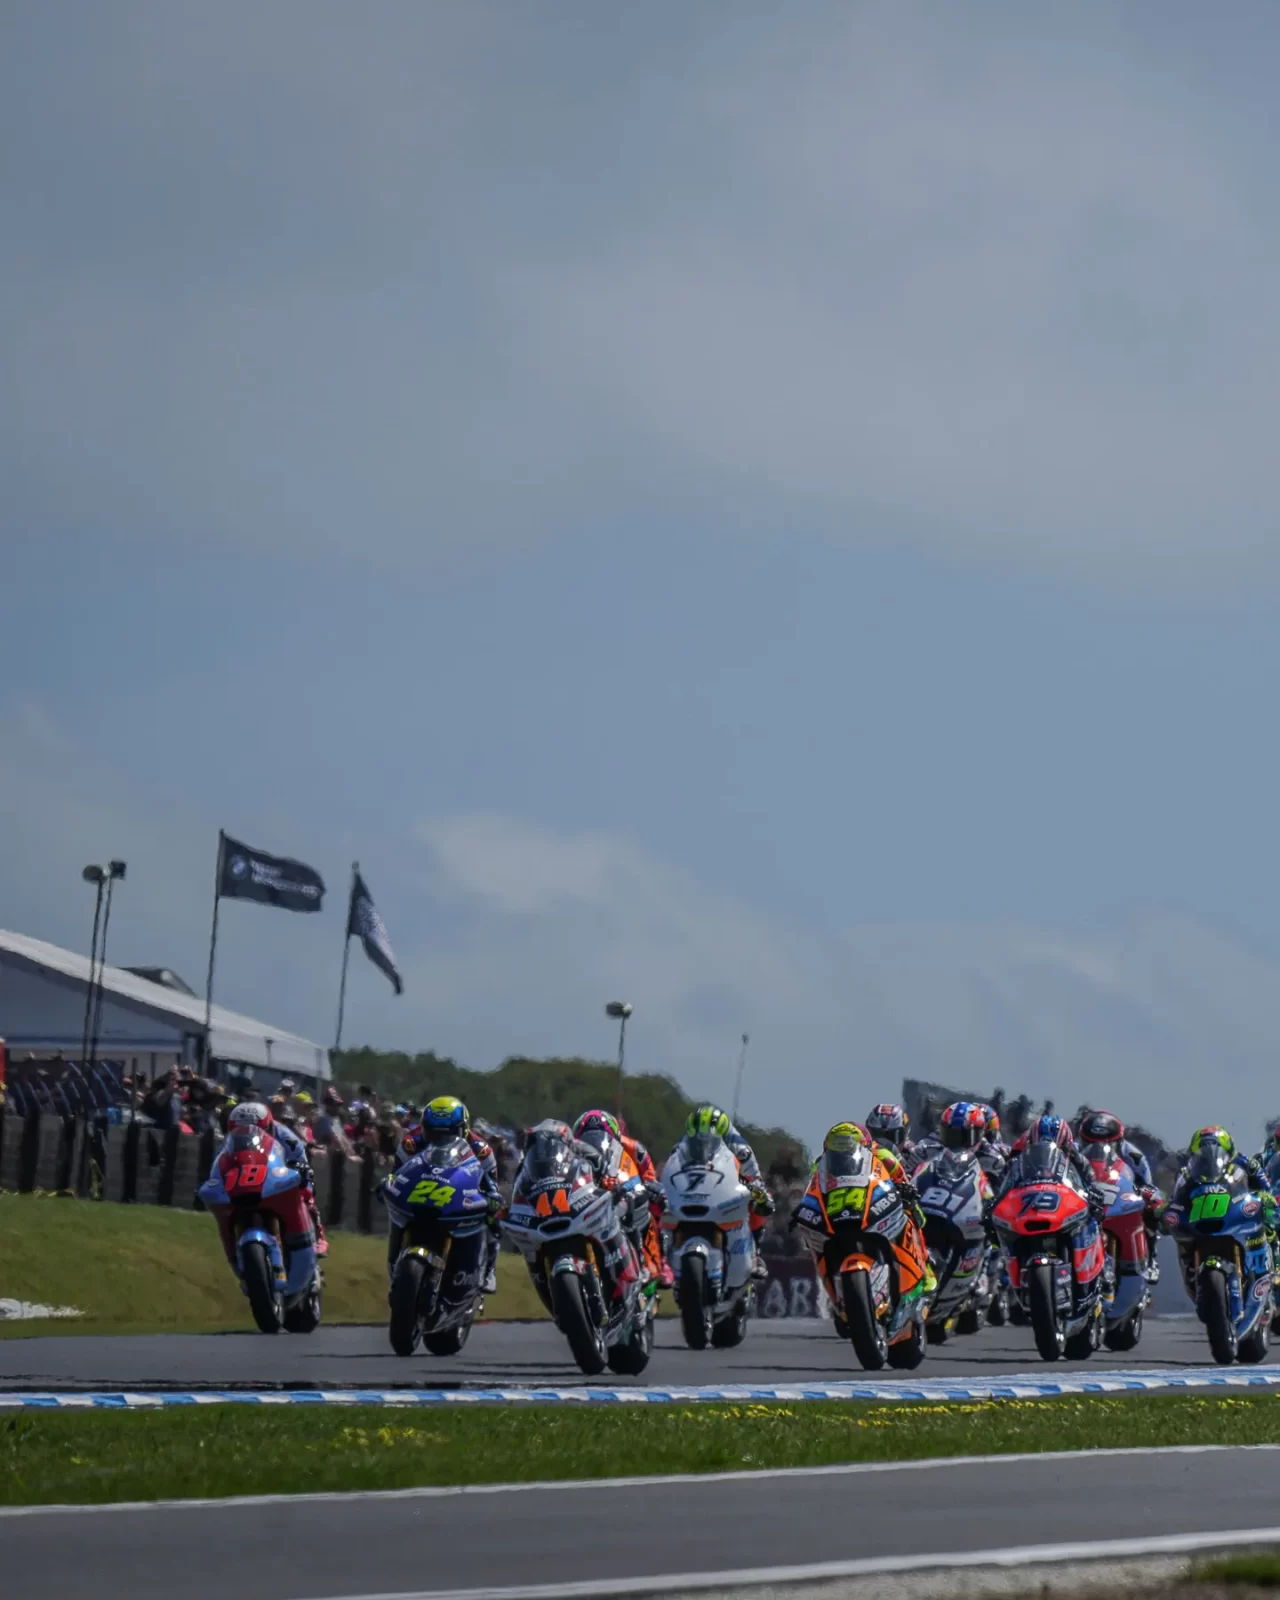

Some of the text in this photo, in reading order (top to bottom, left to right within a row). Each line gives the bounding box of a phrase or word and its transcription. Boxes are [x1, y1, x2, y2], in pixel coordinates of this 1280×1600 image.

[406, 1180, 456, 1208] 24
[684, 1172, 708, 1192] 7
[826, 1187, 867, 1217] 54
[919, 1186, 965, 1213] 81
[1016, 1191, 1060, 1218] 79
[1189, 1194, 1231, 1223] 10
